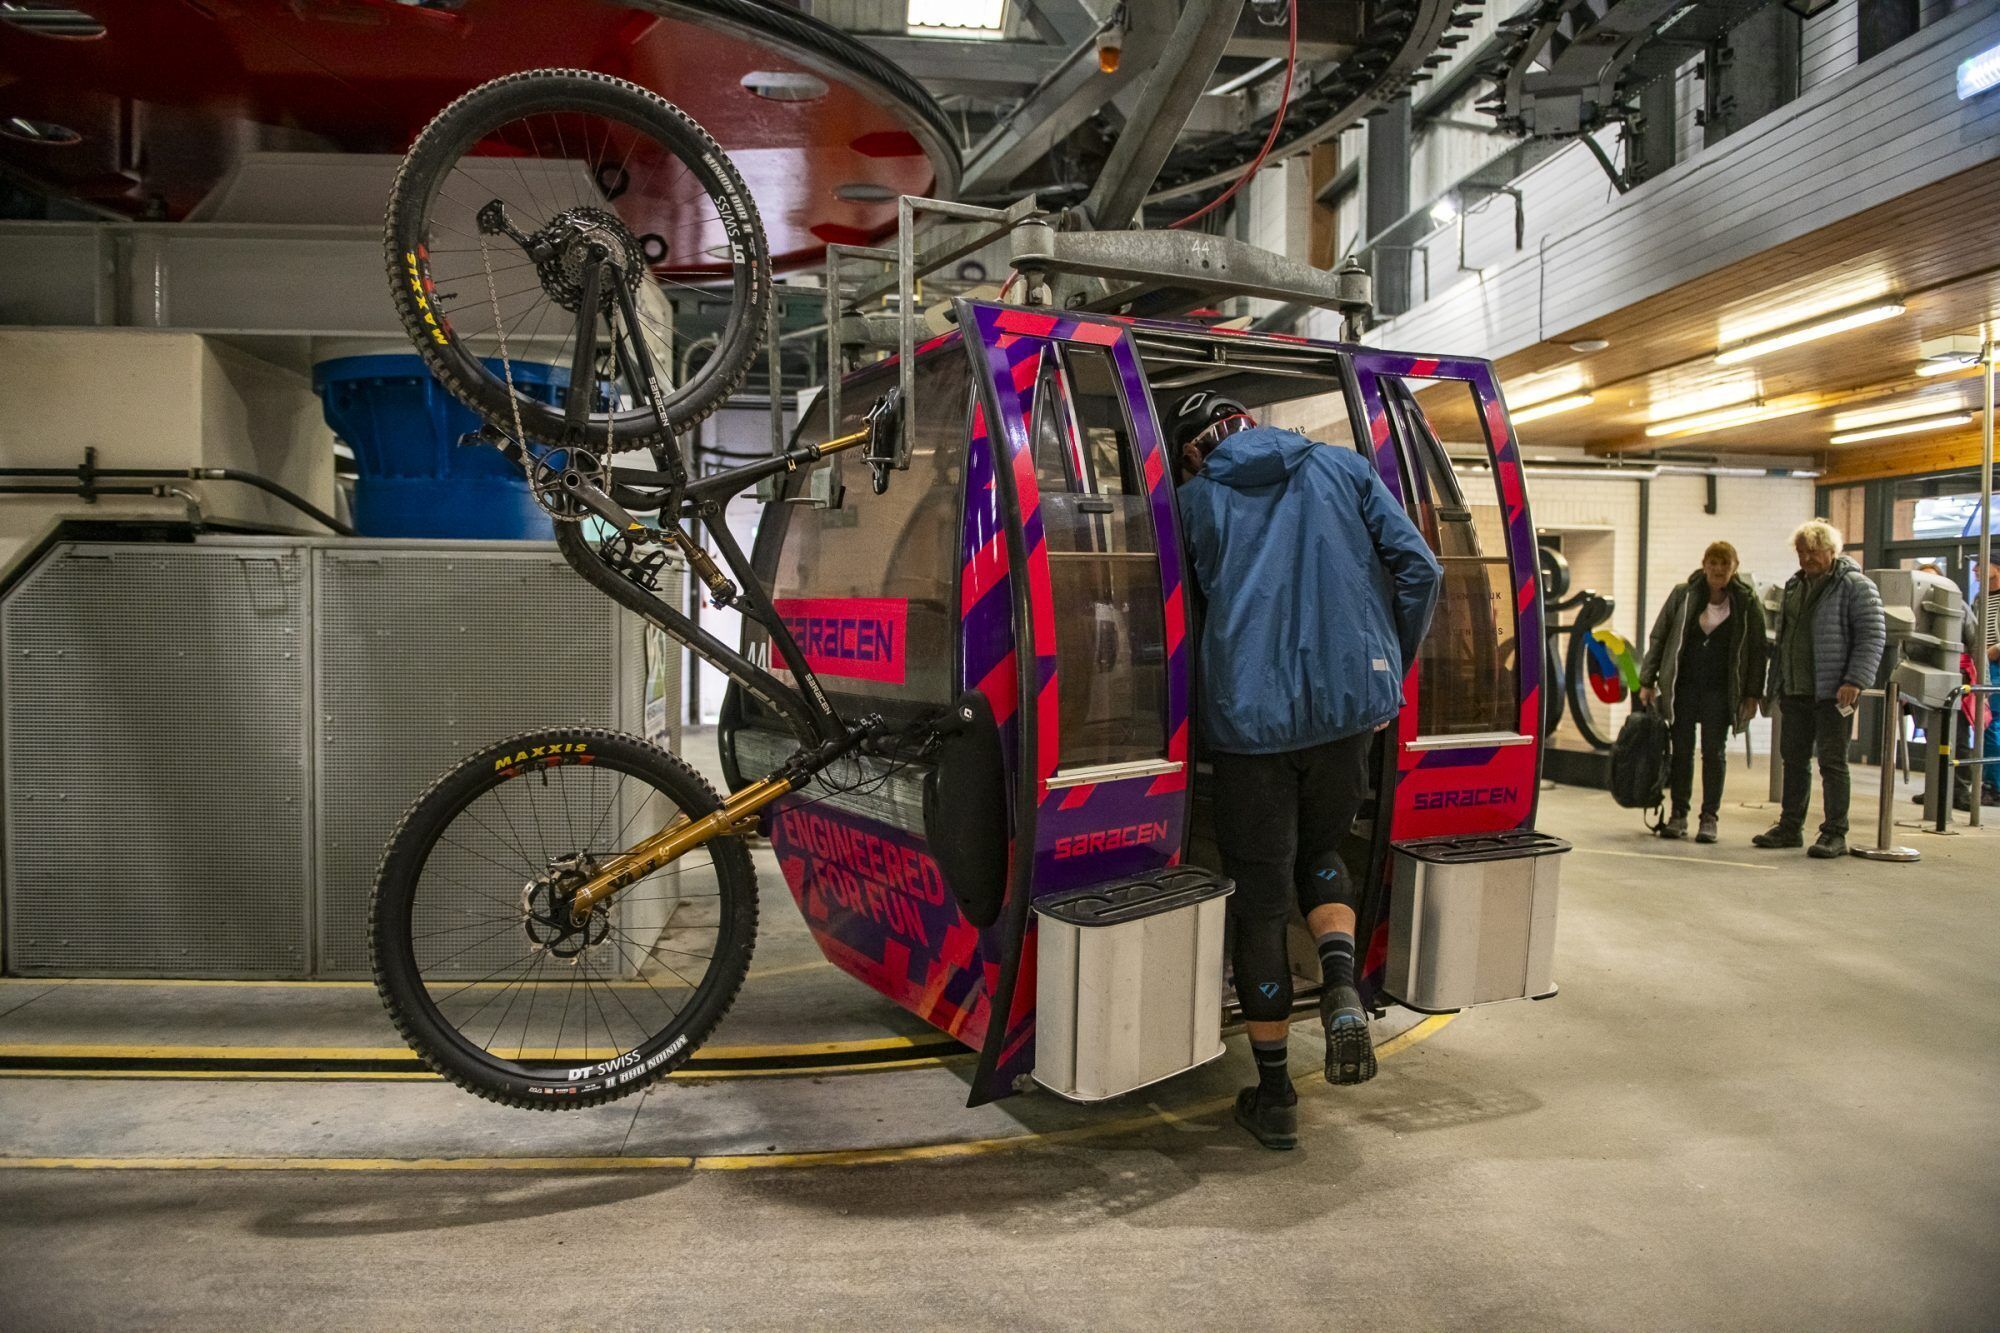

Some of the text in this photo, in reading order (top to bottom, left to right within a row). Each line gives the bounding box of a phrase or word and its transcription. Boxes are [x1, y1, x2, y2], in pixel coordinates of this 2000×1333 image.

[702, 152, 736, 194] MINION
[730, 193, 749, 221] DHR
[714, 195, 746, 265] DT SWISS
[1191, 240, 1210, 257] 44
[406, 252, 449, 345] MAXXIS
[495, 743, 588, 770] MAXXIS
[782, 806, 944, 907] ENGINEERED
[812, 858, 929, 948] FOR FUN
[568, 1049, 641, 1081] DT SWISS
[619, 1063, 647, 1084] DHR
[646, 1034, 689, 1070] MINION
